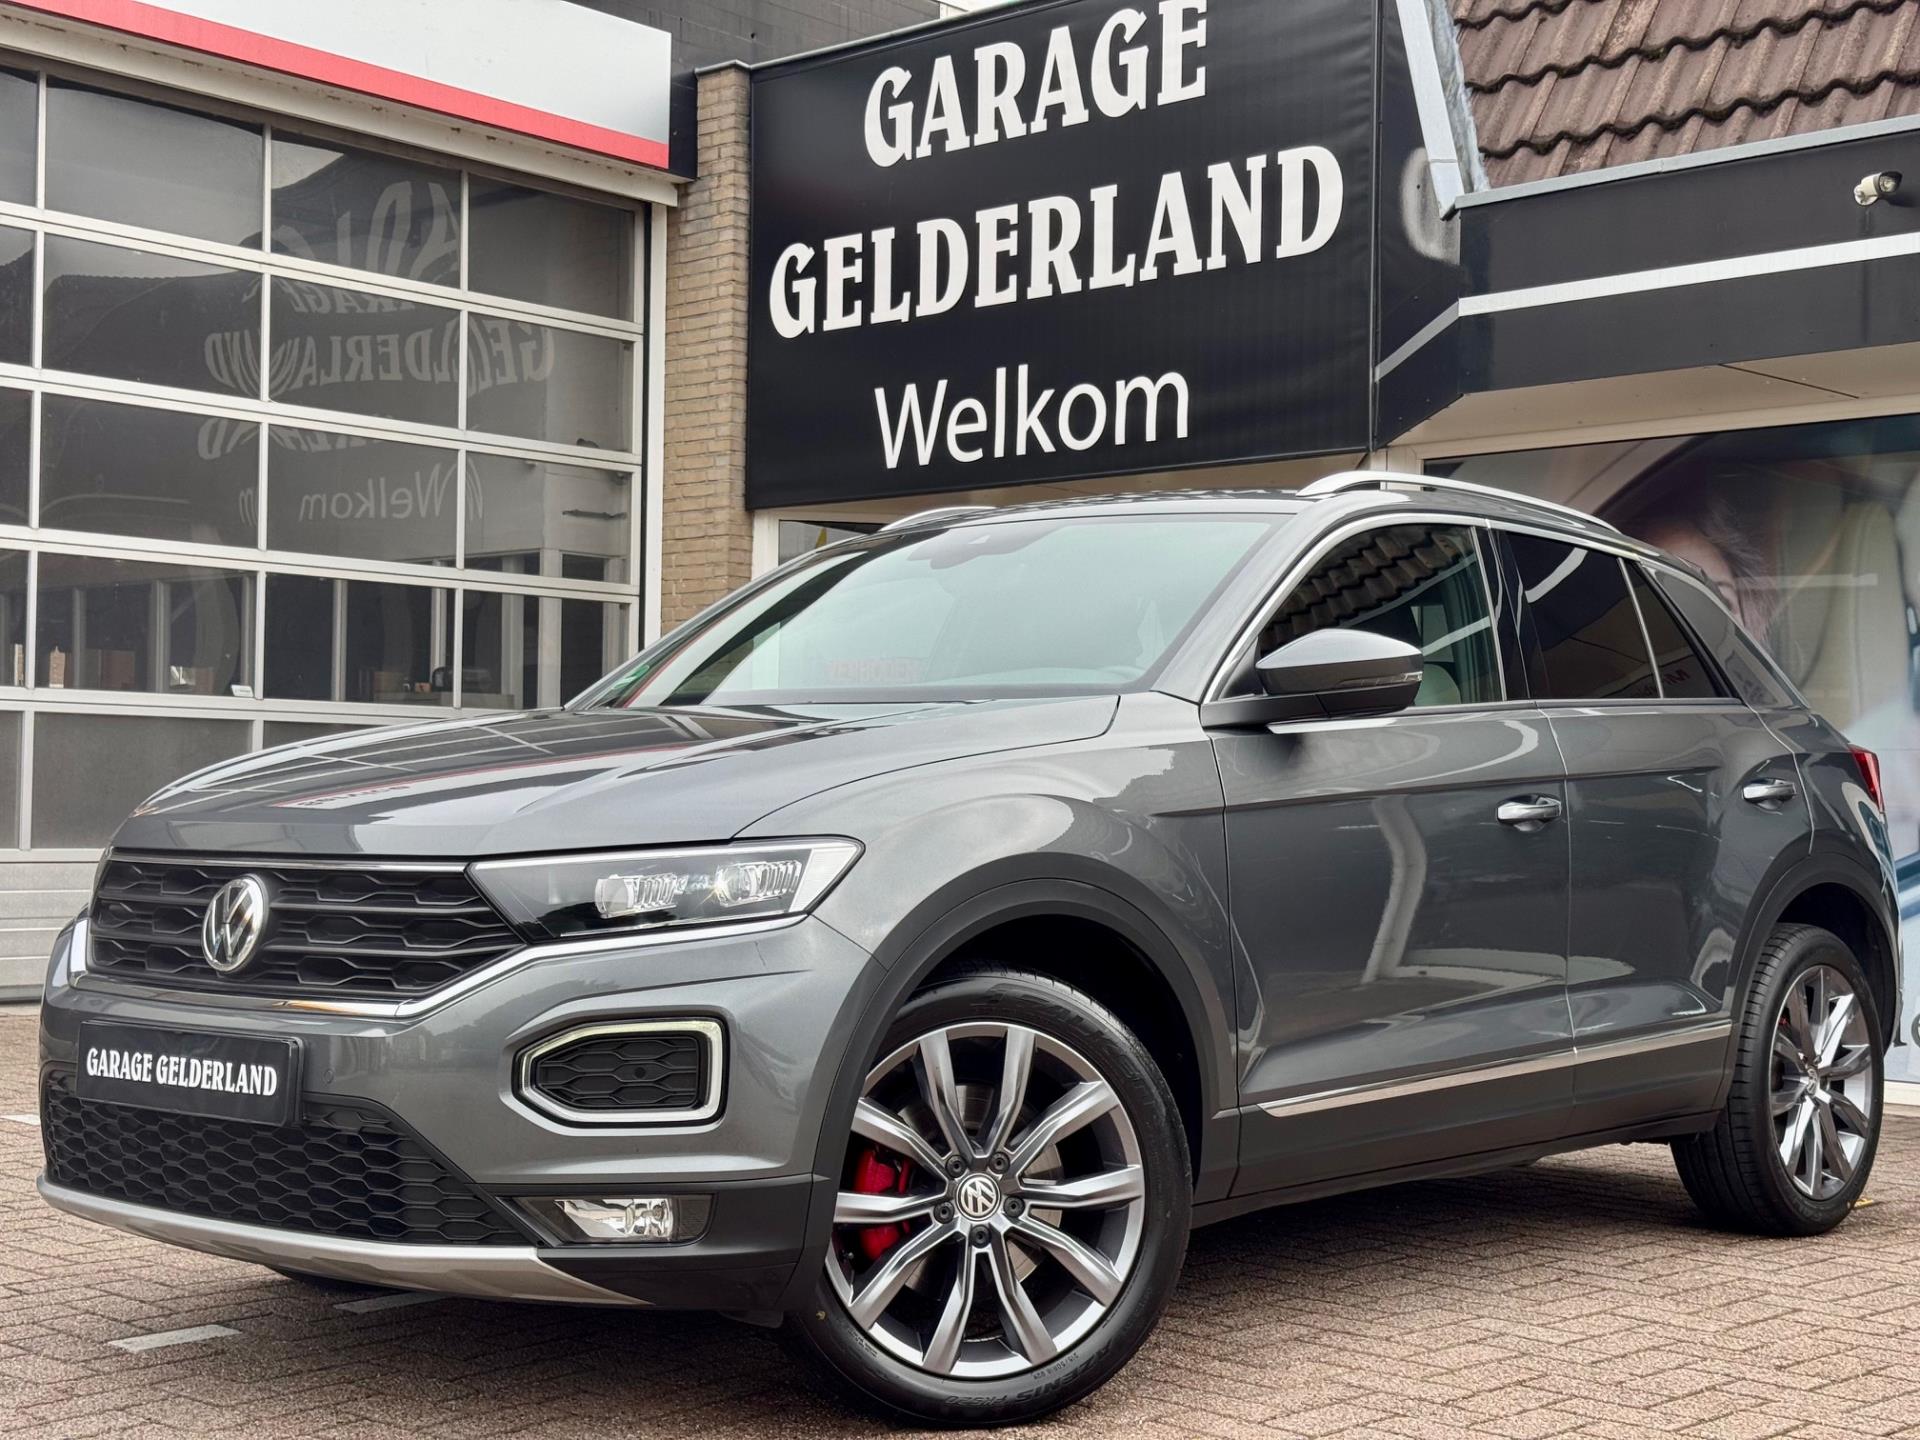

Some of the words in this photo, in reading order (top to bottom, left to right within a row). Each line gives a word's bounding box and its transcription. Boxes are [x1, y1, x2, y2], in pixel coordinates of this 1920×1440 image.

[864, 0, 1207, 167] GARAGE
[769, 145, 1344, 338] GELDERLAND
[874, 363, 1189, 469] Welkom
[86, 1047, 153, 1083] GARAGE
[155, 1055, 278, 1097] GELDERLAND
